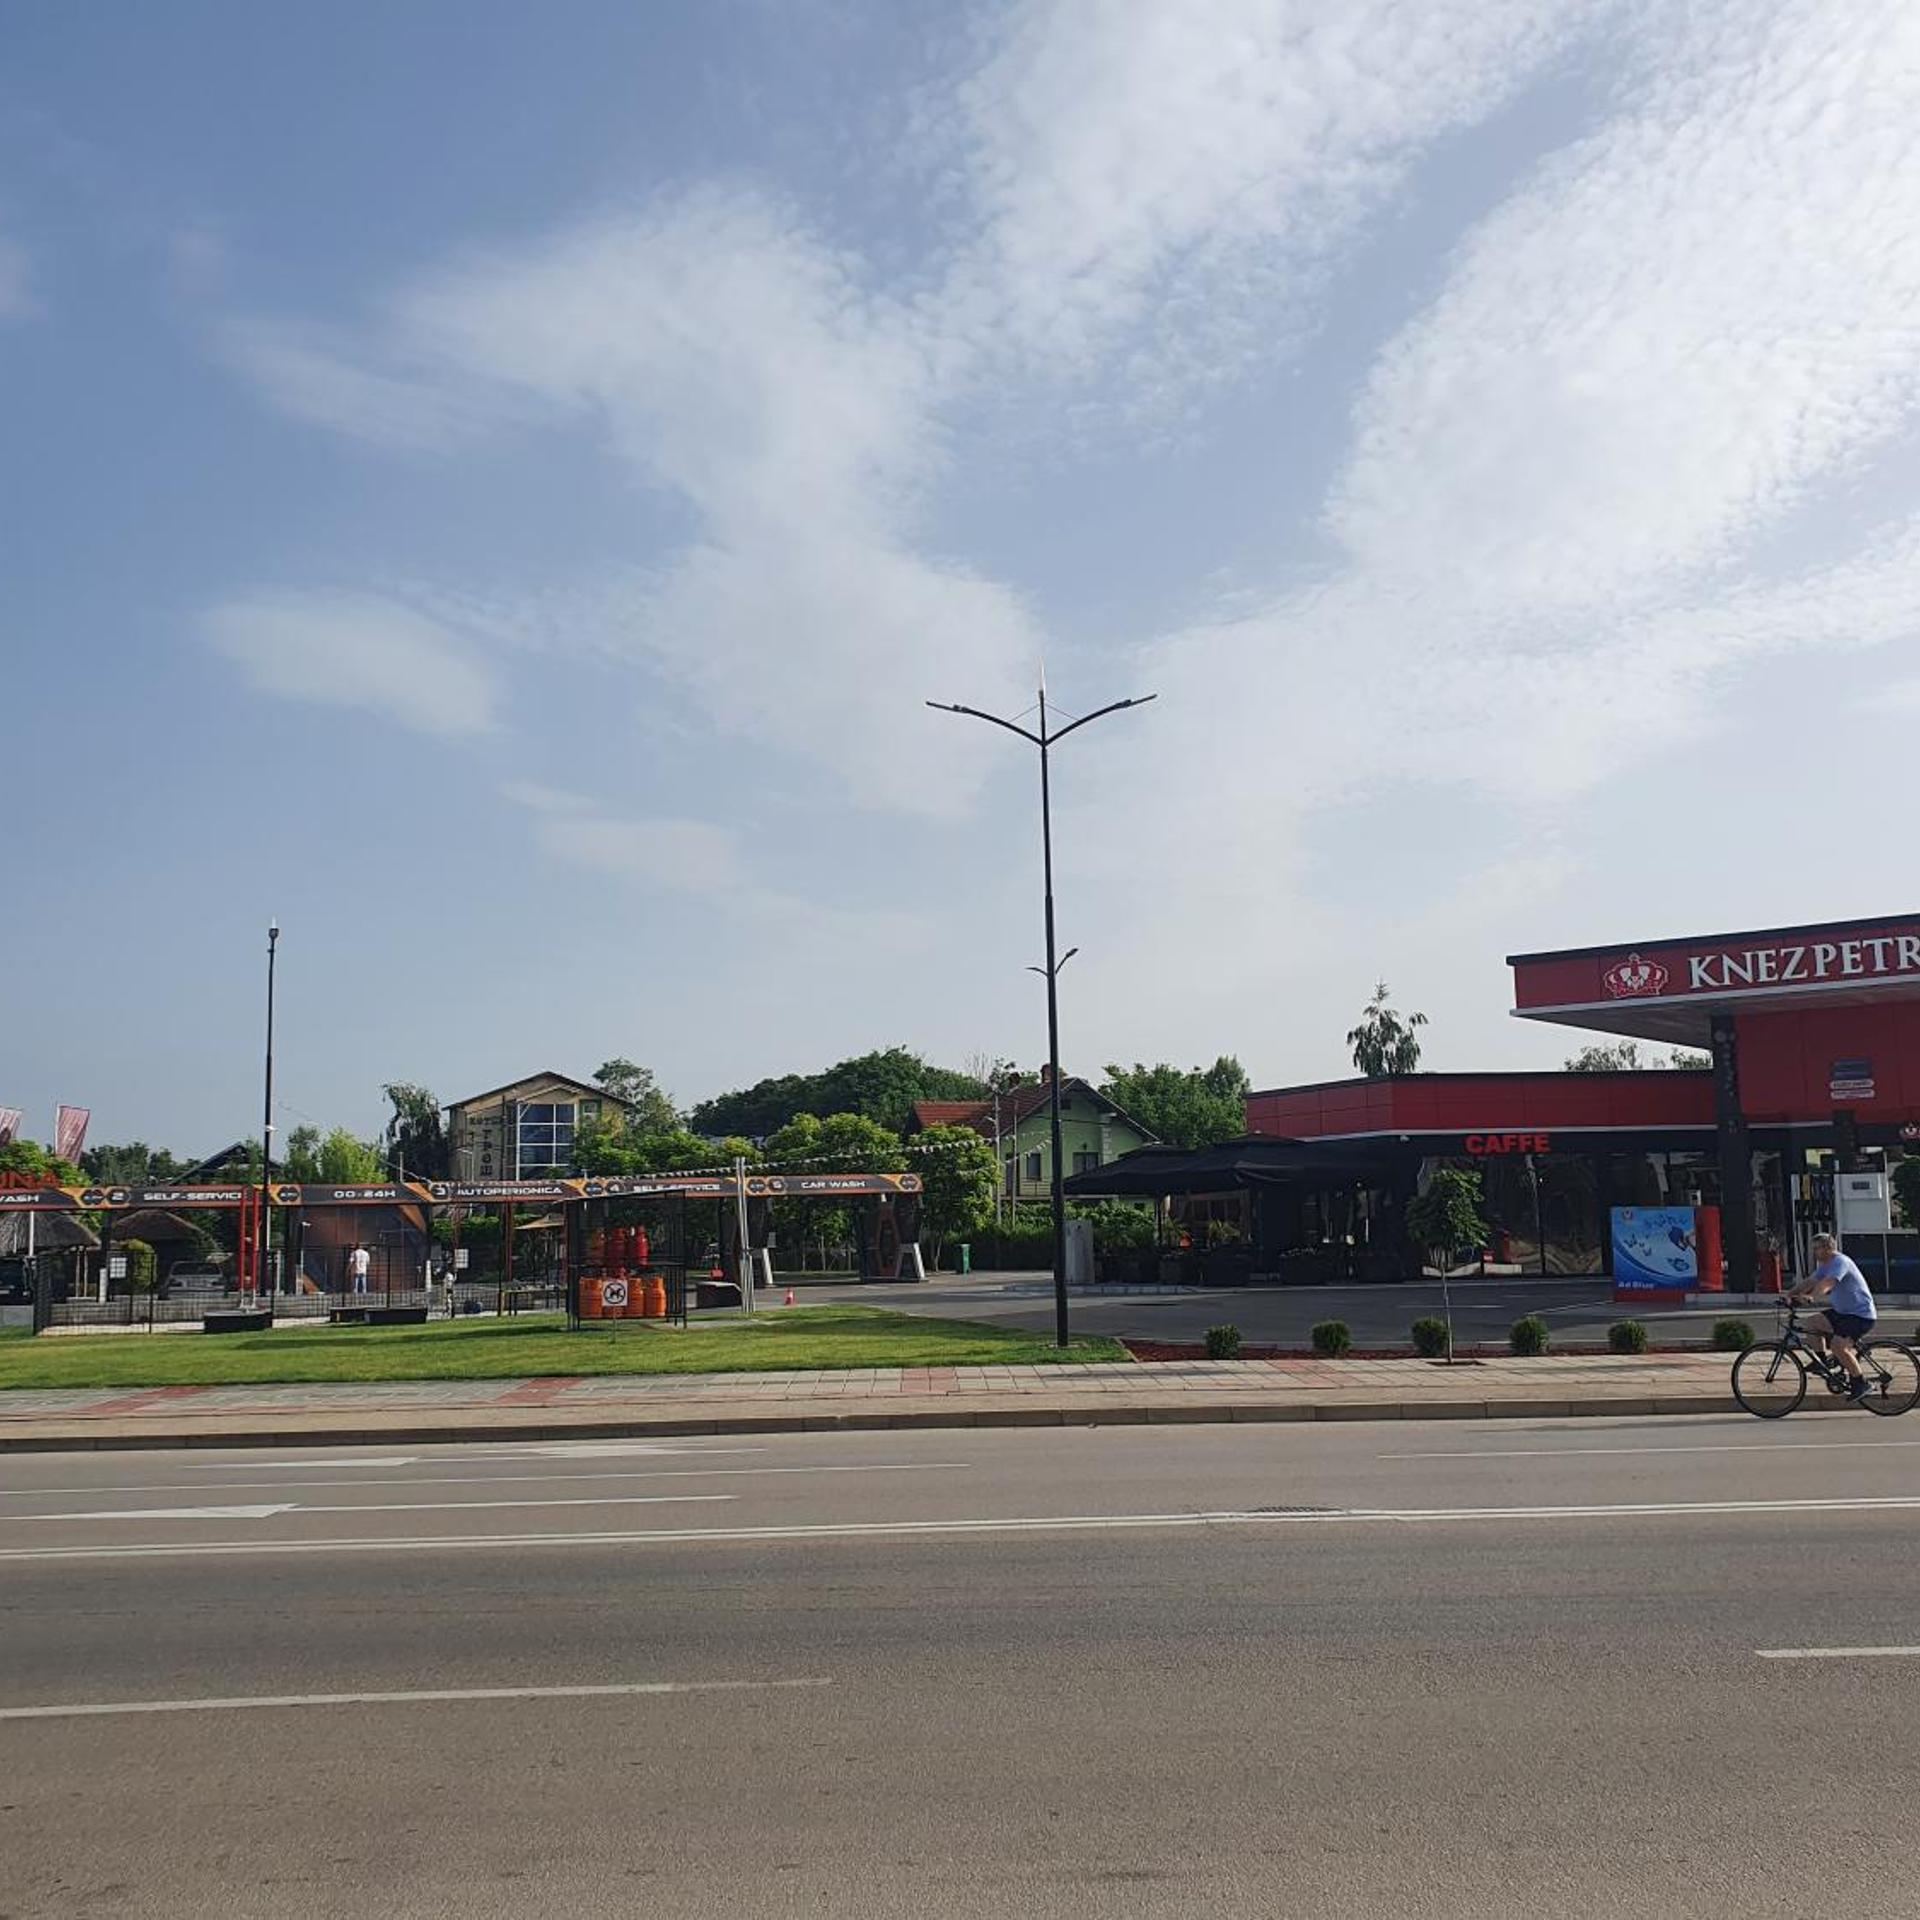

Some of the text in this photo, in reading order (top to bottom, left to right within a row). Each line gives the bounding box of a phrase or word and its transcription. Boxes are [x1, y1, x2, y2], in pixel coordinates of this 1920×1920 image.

[1465, 1134, 1551, 1153] CAFFE
[800, 1180, 866, 1189] CAR WASH
